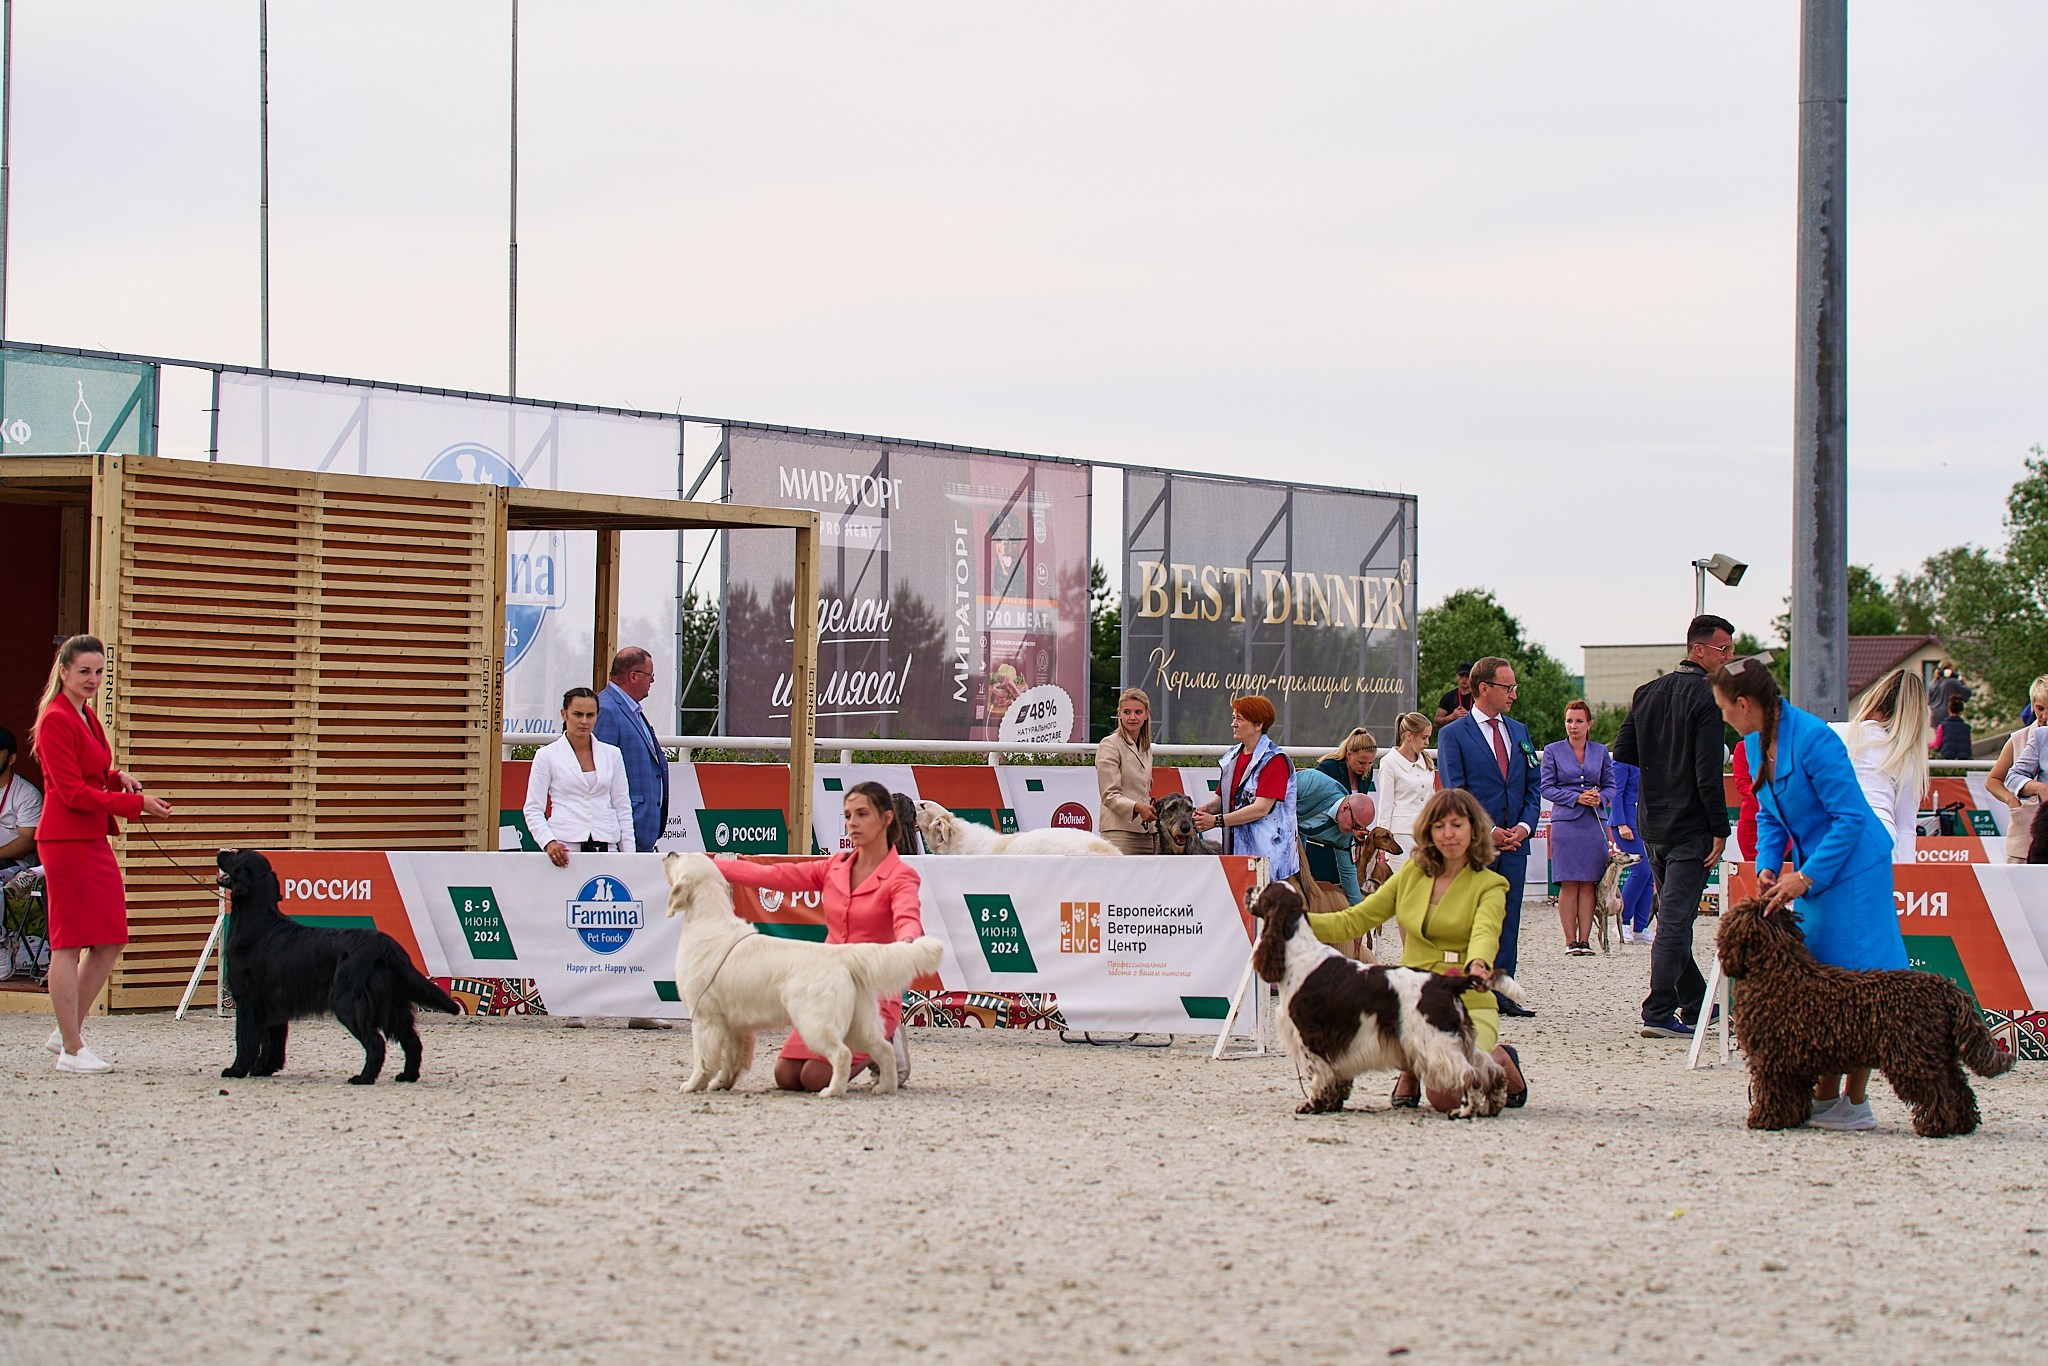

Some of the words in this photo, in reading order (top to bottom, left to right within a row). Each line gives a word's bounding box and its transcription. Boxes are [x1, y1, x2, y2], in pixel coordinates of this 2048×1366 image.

[779, 465, 903, 510] МИРАТОРГ
[820, 522, 840, 535] PRO
[845, 523, 873, 538] MEAT
[1137, 560, 1251, 622] BEST
[1261, 569, 1408, 631] DINNER
[952, 519, 971, 703] МИРАТОРГ
[986, 609, 1011, 627] PRO
[1017, 612, 1048, 629] MEAT
[790, 596, 893, 648] делан
[817, 652, 913, 707] мяса!
[1148, 646, 1220, 700] Корма
[1224, 670, 1352, 708] супер-премиум
[1355, 676, 1405, 695] класса
[105, 646, 115, 726] CORNER
[481, 658, 490, 730] CORNER
[494, 660, 503, 732] CORNER
[1029, 698, 1057, 720] 48%
[1017, 721, 1057, 736] НАТУРАЛЬНОГО
[1058, 812, 1086, 825] Родные
[732, 826, 777, 842] РОССИЯ
[1915, 849, 1969, 862] ОССИЯ
[284, 878, 372, 900] РОССИЯ
[571, 904, 638, 925] Farmina
[1107, 903, 1194, 919] Европейский
[464, 916, 499, 927] ИЮНЯ
[1107, 921, 1203, 937] Ветеринарный
[473, 931, 501, 942] 2024
[587, 932, 600, 943] Pet
[601, 932, 624, 943] Foods
[981, 926, 1017, 937] ИЮНЯ
[991, 941, 1019, 954] 2024
[1062, 938, 1099, 951] EVC
[1107, 938, 1147, 954] Центр
[566, 963, 588, 973] Happy
[589, 964, 603, 974] pet.
[604, 963, 627, 974] Happy
[629, 965, 645, 974] you.
[1107, 960, 1168, 969] Профессиональная
[1108, 968, 1131, 976] забота
[1138, 968, 1160, 977] вашем
